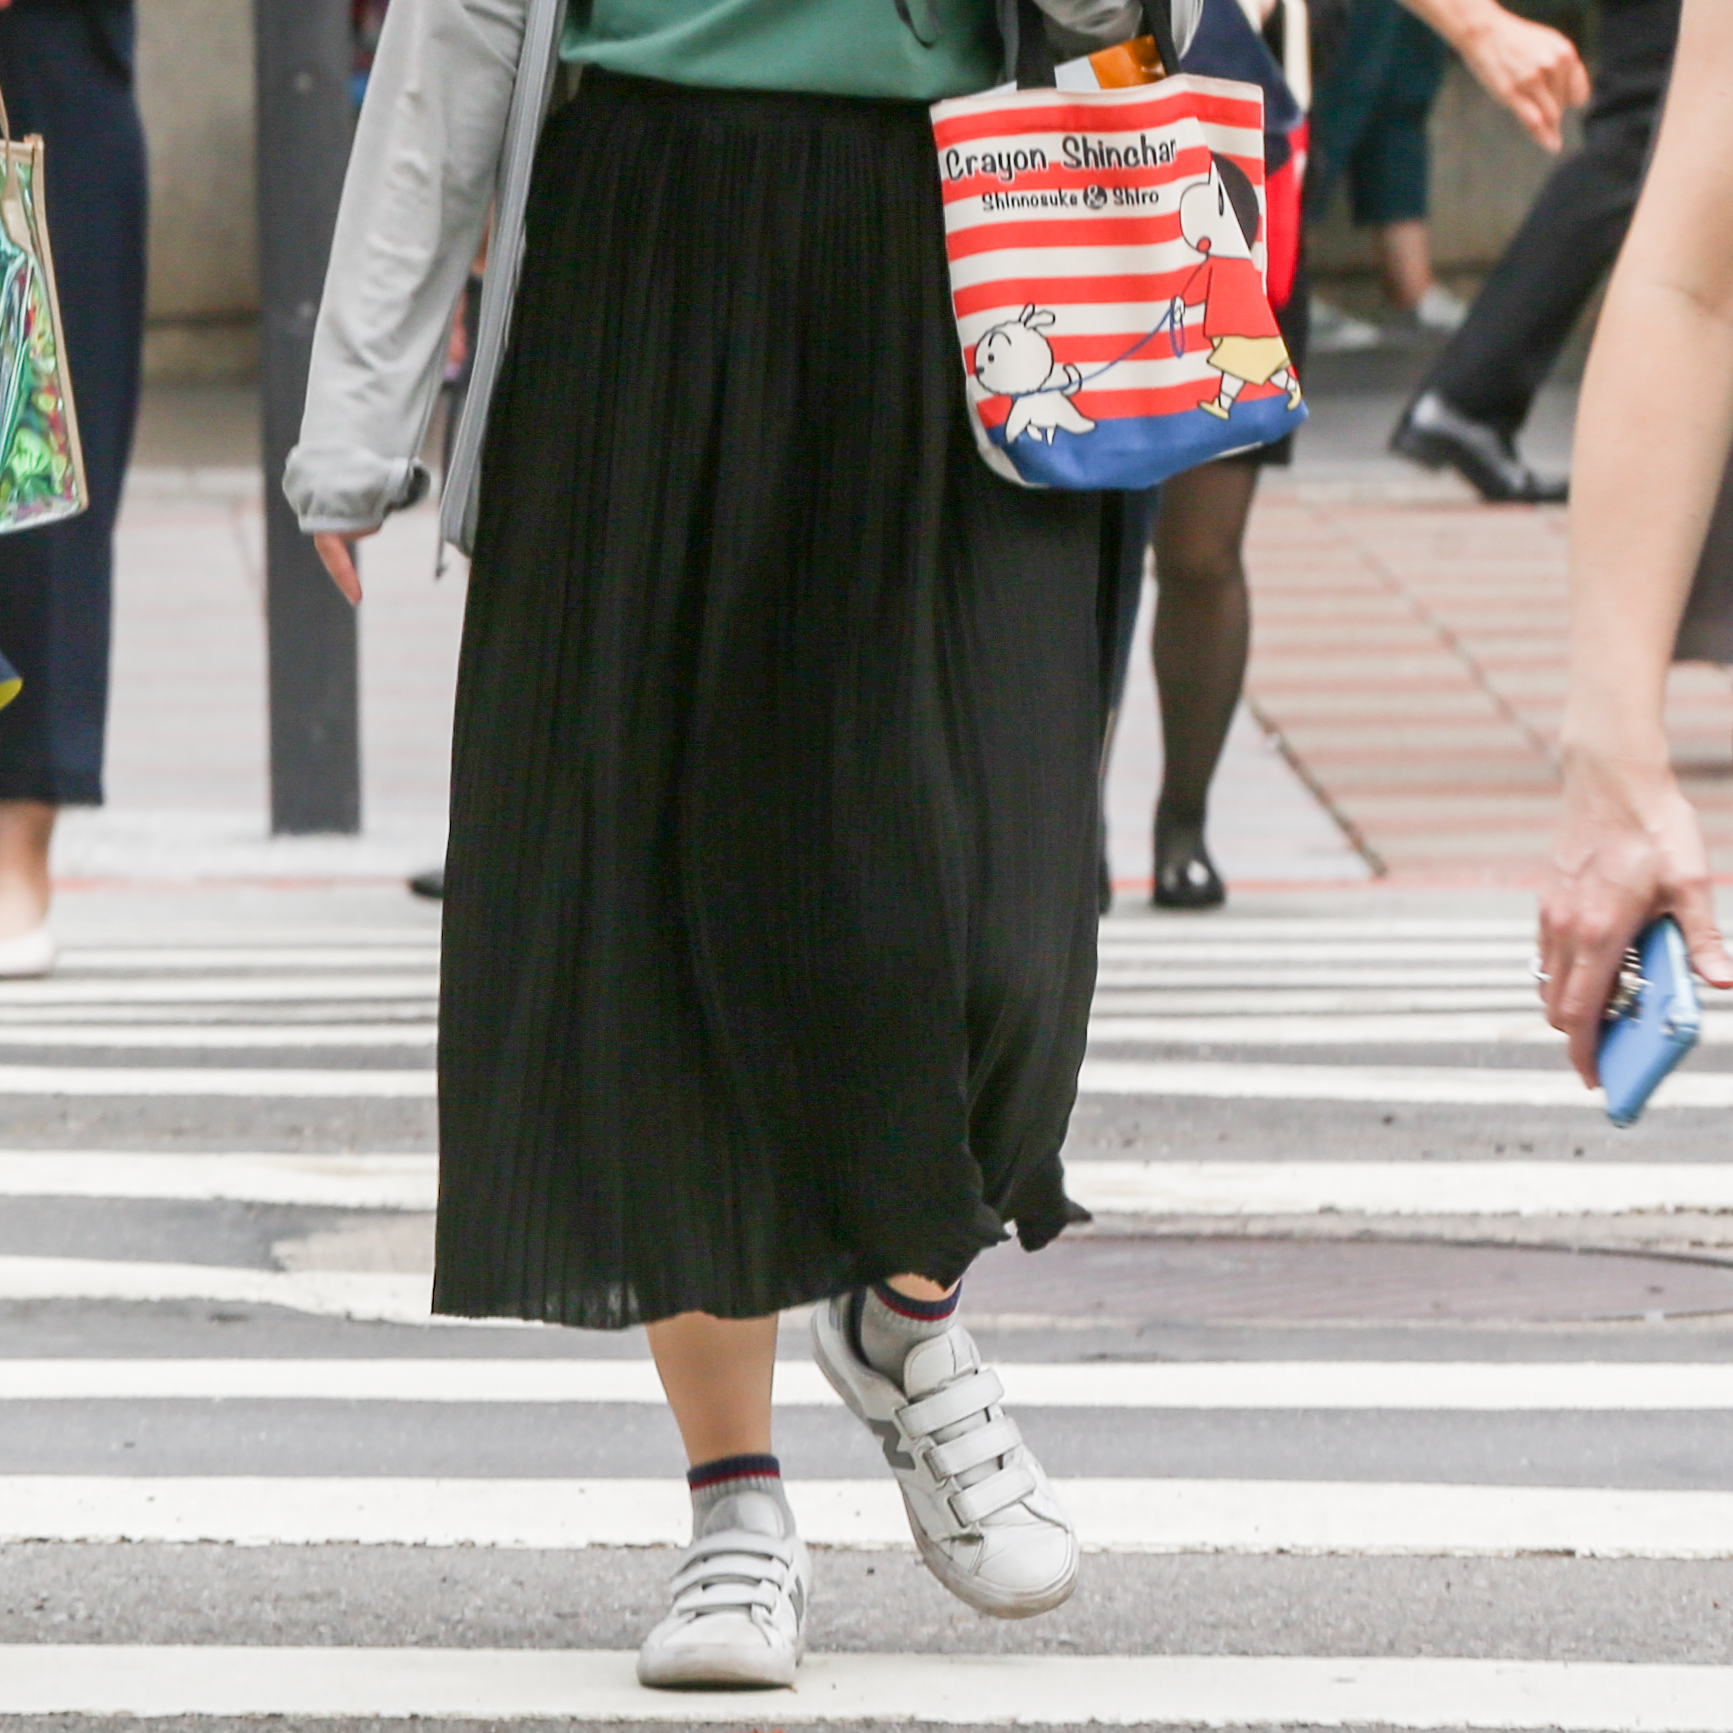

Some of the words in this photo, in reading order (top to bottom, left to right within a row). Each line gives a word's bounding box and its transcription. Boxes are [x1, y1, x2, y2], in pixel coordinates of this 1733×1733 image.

[945, 147, 1047, 182] Crayon
[982, 188, 1078, 212] Shinnosuke
[1112, 186, 1160, 207] Shiro
